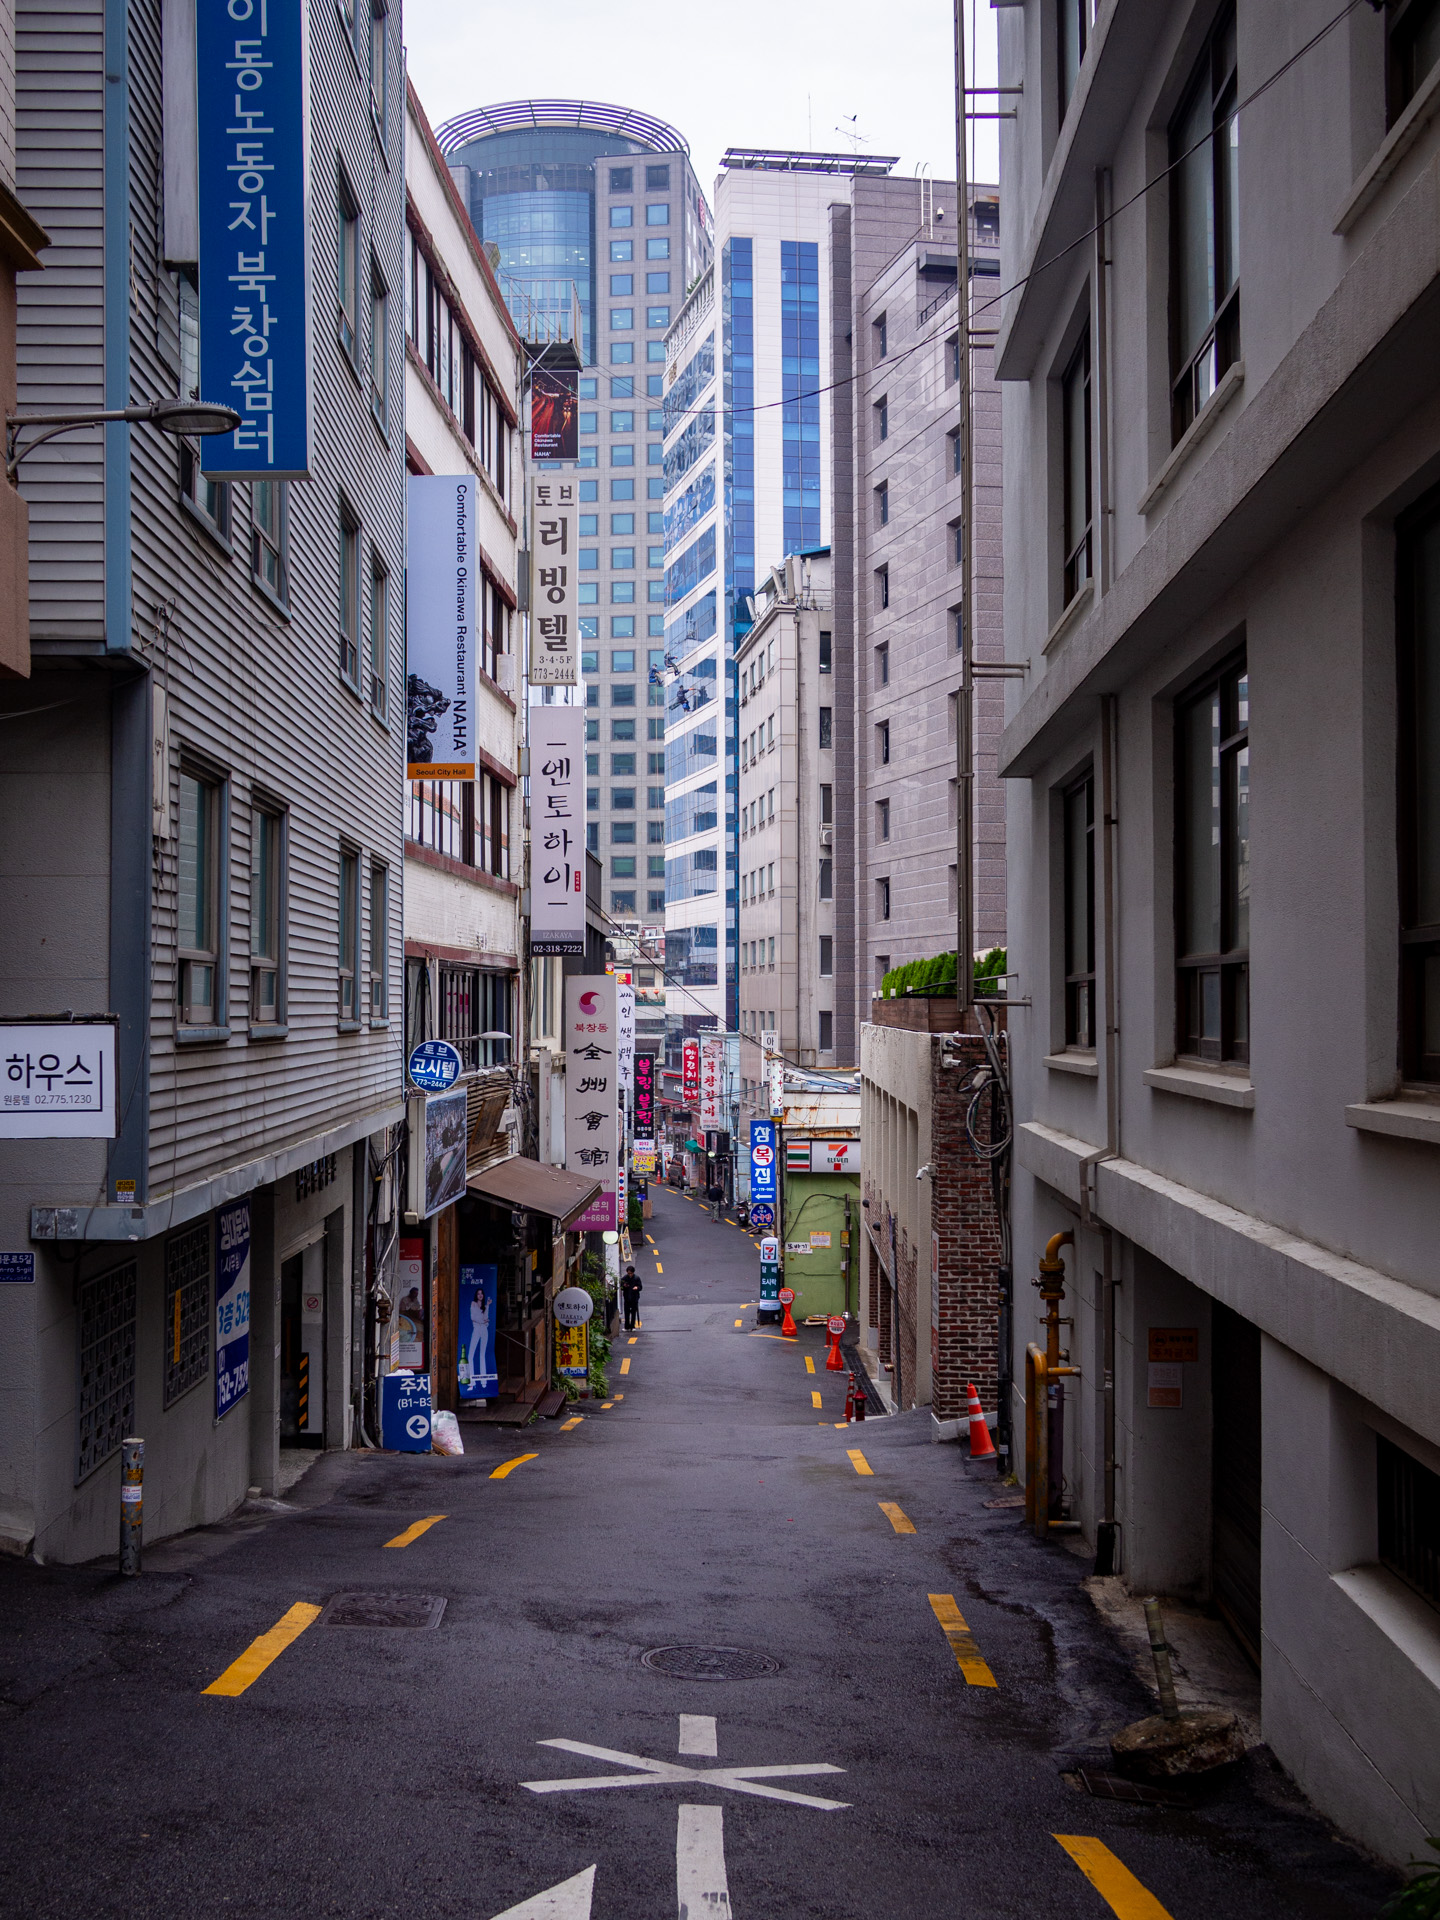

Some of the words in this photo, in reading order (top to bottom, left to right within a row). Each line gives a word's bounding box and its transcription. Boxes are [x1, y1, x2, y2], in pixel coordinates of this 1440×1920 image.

[536, 485, 574, 506] 토브
[457, 484, 467, 563] Comfortable
[537, 517, 568, 652] 리빙텔
[457, 567, 467, 622] Okinawa
[457, 626, 467, 695] Restaurant
[534, 668, 575, 680] 773-2444
[541, 757, 573, 893] 엔토하이
[533, 944, 582, 953] 02-318-7222
[574, 1023, 609, 1032] 북창동
[422, 1044, 448, 1057] 토브
[6, 1053, 93, 1091] 하우스
[411, 1056, 457, 1081] 고시텔
[415, 1078, 447, 1089] 773-2444
[4, 1095, 30, 1106] 원룸텔
[34, 1095, 92, 1104] 02.775.1230
[754, 1126, 771, 1184] 참복집
[588, 1201, 608, 1211] 문의
[0, 1255, 32, 1264] 문로5길
[16, 1266, 32, 1274] 5-gil
[762, 1278, 777, 1286] 도시락
[558, 1302, 588, 1312] 엔토하이
[1152, 1348, 1194, 1358] 주차금지
